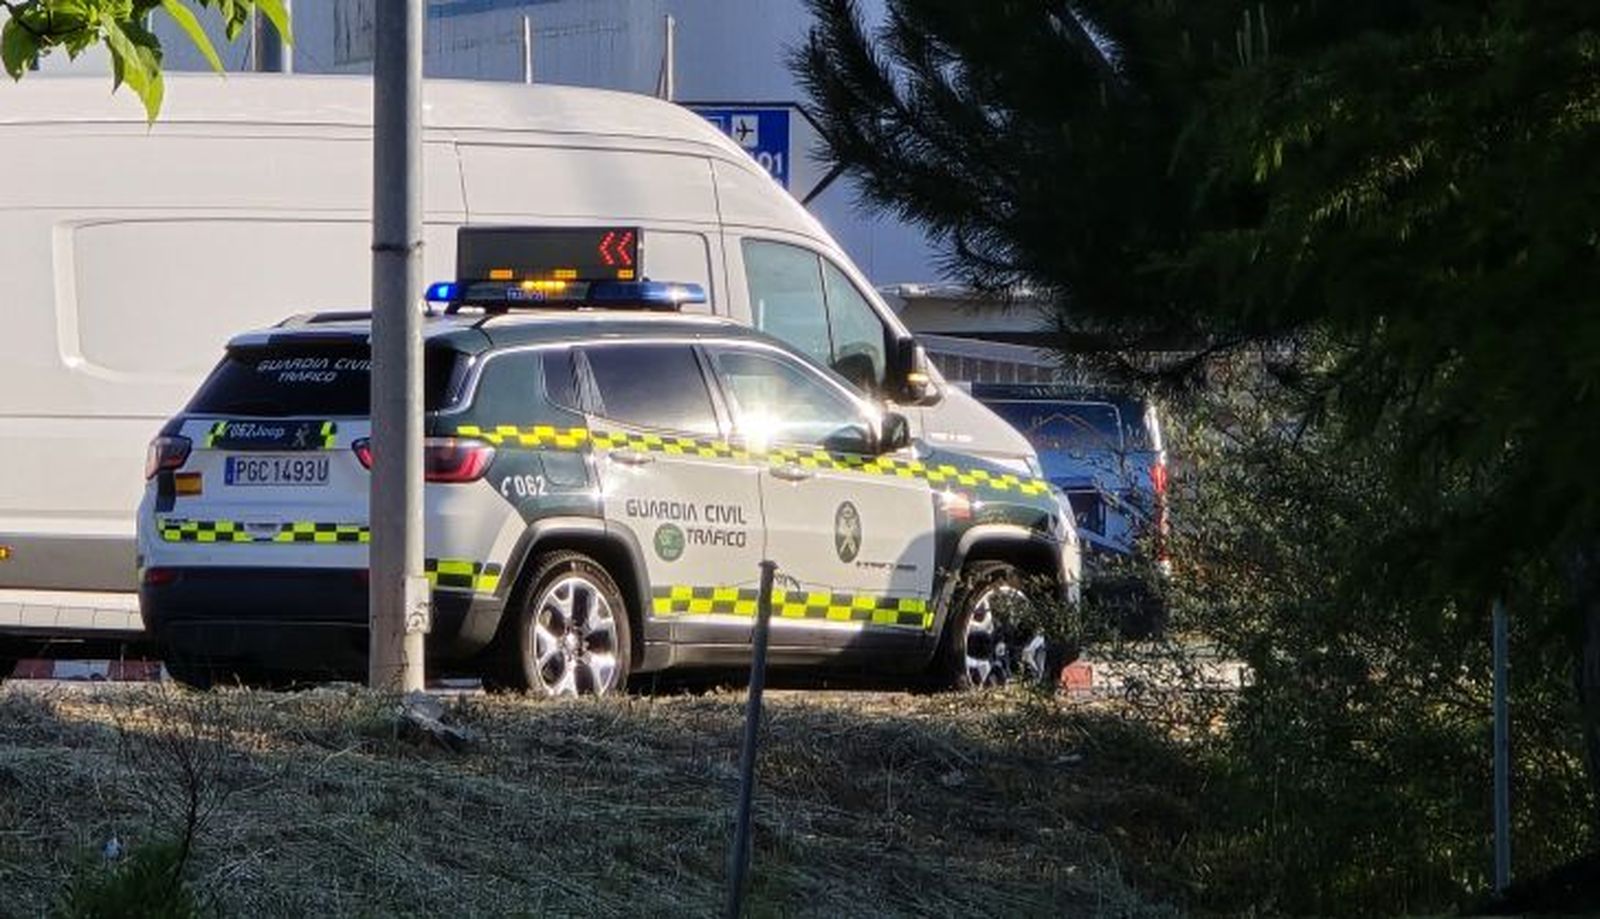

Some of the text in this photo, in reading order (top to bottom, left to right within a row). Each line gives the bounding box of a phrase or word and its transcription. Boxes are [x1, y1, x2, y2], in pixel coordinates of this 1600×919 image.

[257, 358, 329, 371] GUARDIA
[514, 474, 548, 496] 062
[626, 500, 747, 524] GUARDIA CIVIL
